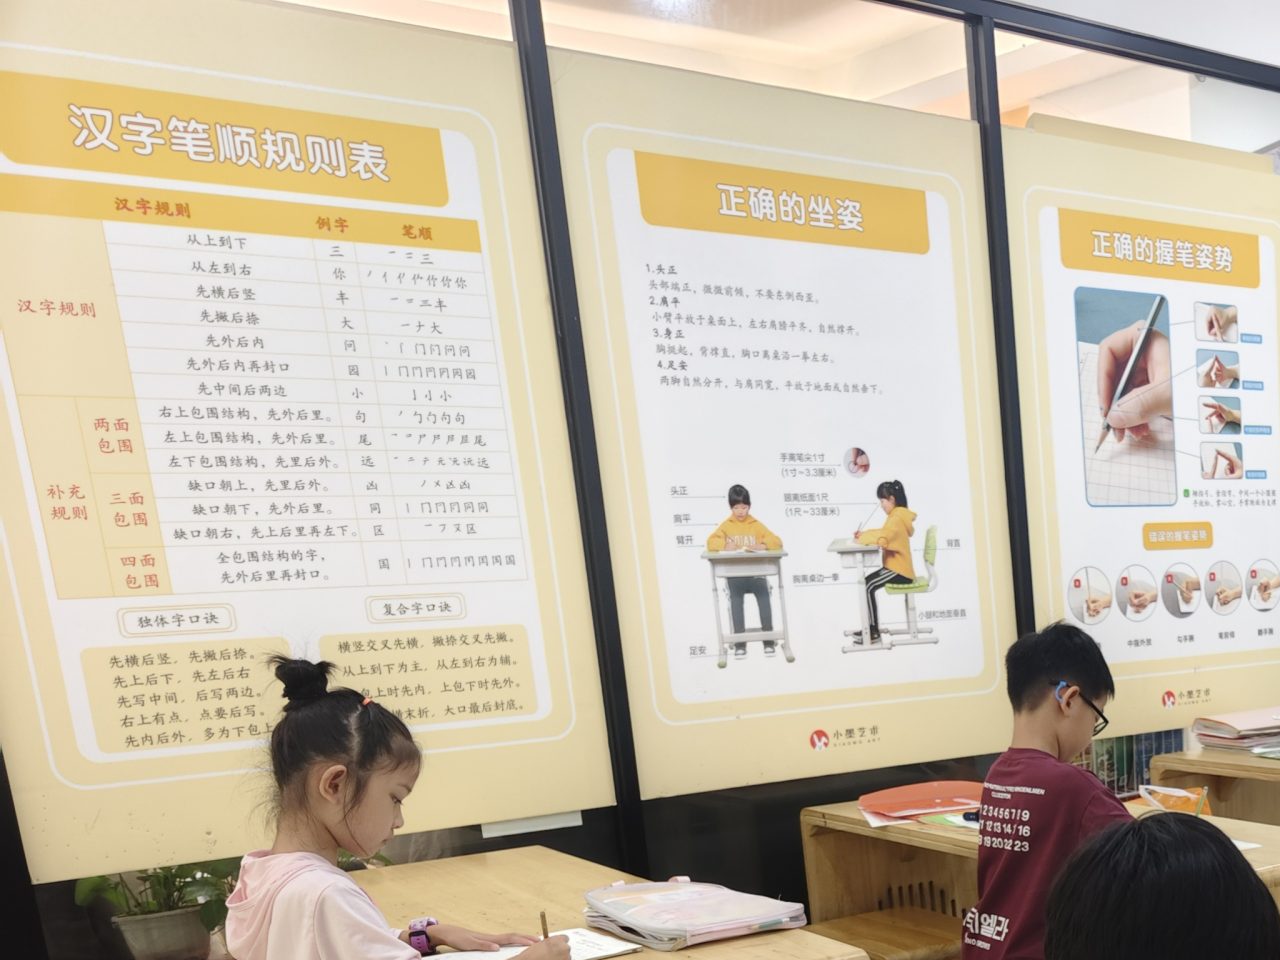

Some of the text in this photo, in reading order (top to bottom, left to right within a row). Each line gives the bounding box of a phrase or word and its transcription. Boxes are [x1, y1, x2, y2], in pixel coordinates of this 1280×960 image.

[68, 103, 390, 183] 汉字笔顺规则表
[115, 197, 192, 219] 汉字规则
[715, 182, 866, 233] 正确的坐姿
[316, 216, 350, 234] 例字
[402, 225, 432, 241] 笔顺
[187, 234, 248, 250] 从上到下
[329, 245, 345, 258] 三
[1090, 229, 1234, 273] 正确的握笔姿势
[191, 260, 252, 276] 从左到右
[333, 267, 346, 280] 你
[196, 285, 257, 301] 先横后竖
[17, 299, 97, 318] 汉字规则
[200, 309, 260, 326] 先撇后捺
[342, 316, 354, 330] 大
[206, 333, 265, 349] 先外后内
[344, 339, 357, 353] 问
[186, 356, 291, 374] 先外后内再封口
[198, 382, 288, 397] 先中间后两边
[352, 387, 364, 399] 小
[355, 410, 366, 423] 句
[94, 417, 130, 433] 两面
[98, 438, 133, 454] 包围
[358, 433, 372, 446] 尾
[361, 455, 376, 468] 远
[47, 483, 86, 501] 补充
[366, 480, 378, 492] 凶
[670, 485, 689, 496] 头正
[109, 491, 146, 506] 三面
[51, 505, 88, 522] 规则
[113, 512, 149, 528] 包围
[373, 525, 385, 536] 区
[120, 553, 157, 568] 四面
[378, 558, 390, 570] 国
[125, 574, 160, 590] 包围
[383, 601, 452, 617] 复合字口诀
[137, 612, 221, 629] 独体字口诀
